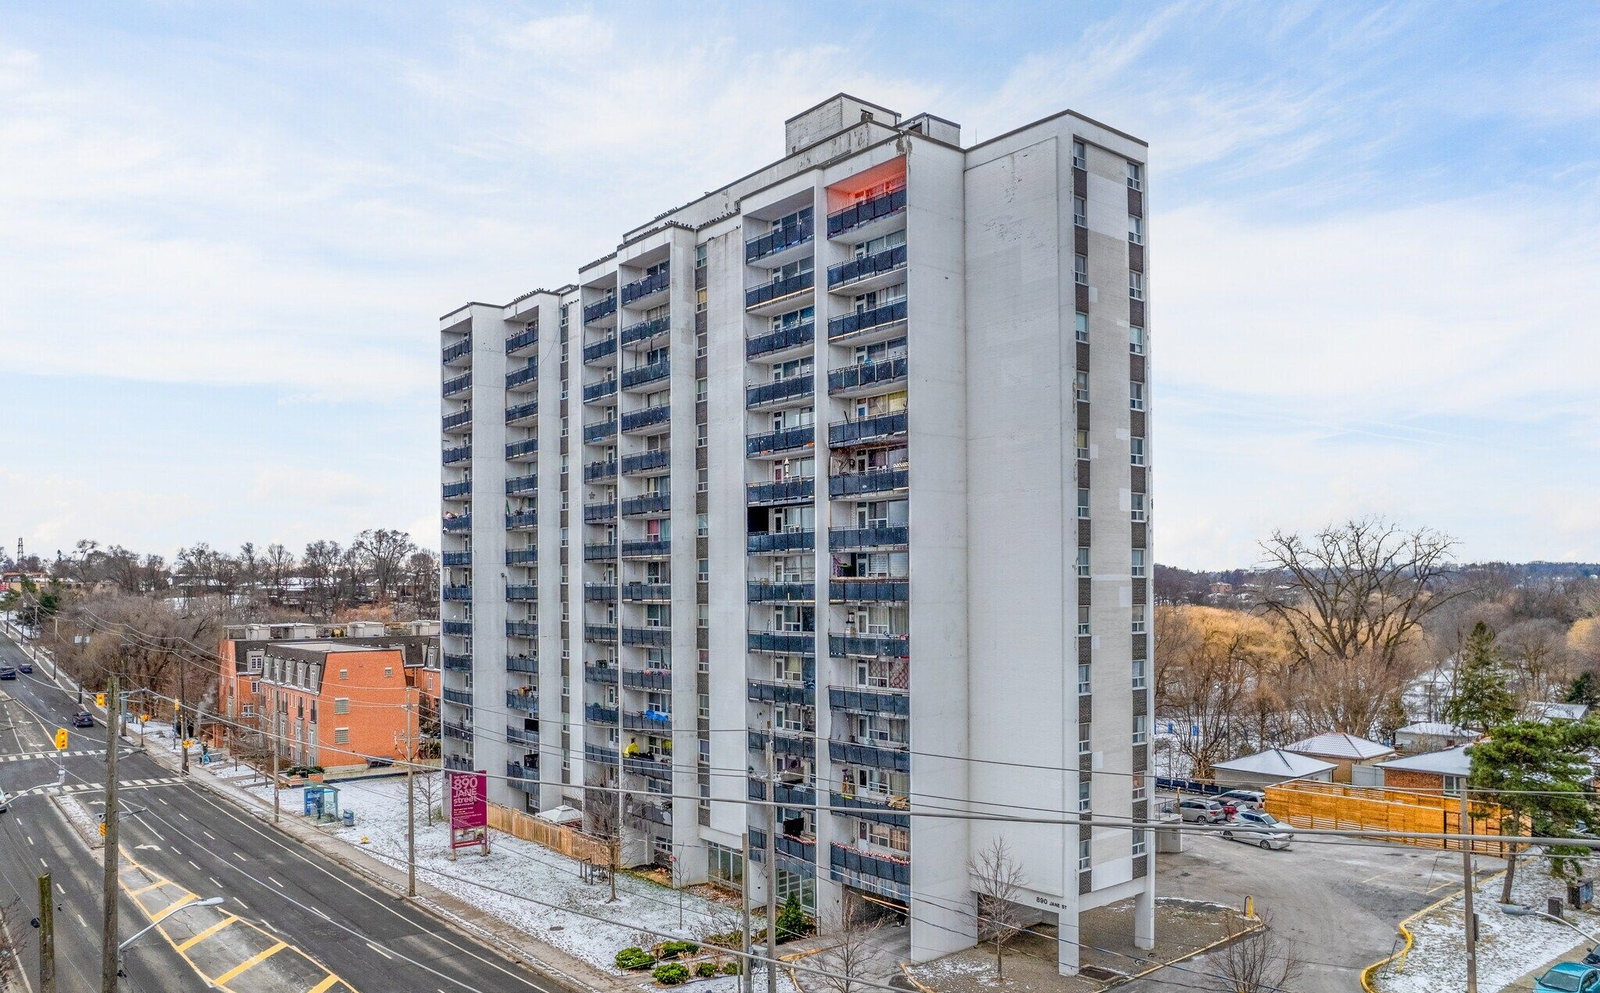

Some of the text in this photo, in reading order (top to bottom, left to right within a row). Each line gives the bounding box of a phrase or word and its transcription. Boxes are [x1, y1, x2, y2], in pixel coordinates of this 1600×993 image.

[453, 777, 478, 790] 890
[453, 788, 477, 798] JANE
[453, 795, 478, 804] street
[1036, 896, 1048, 904] 890
